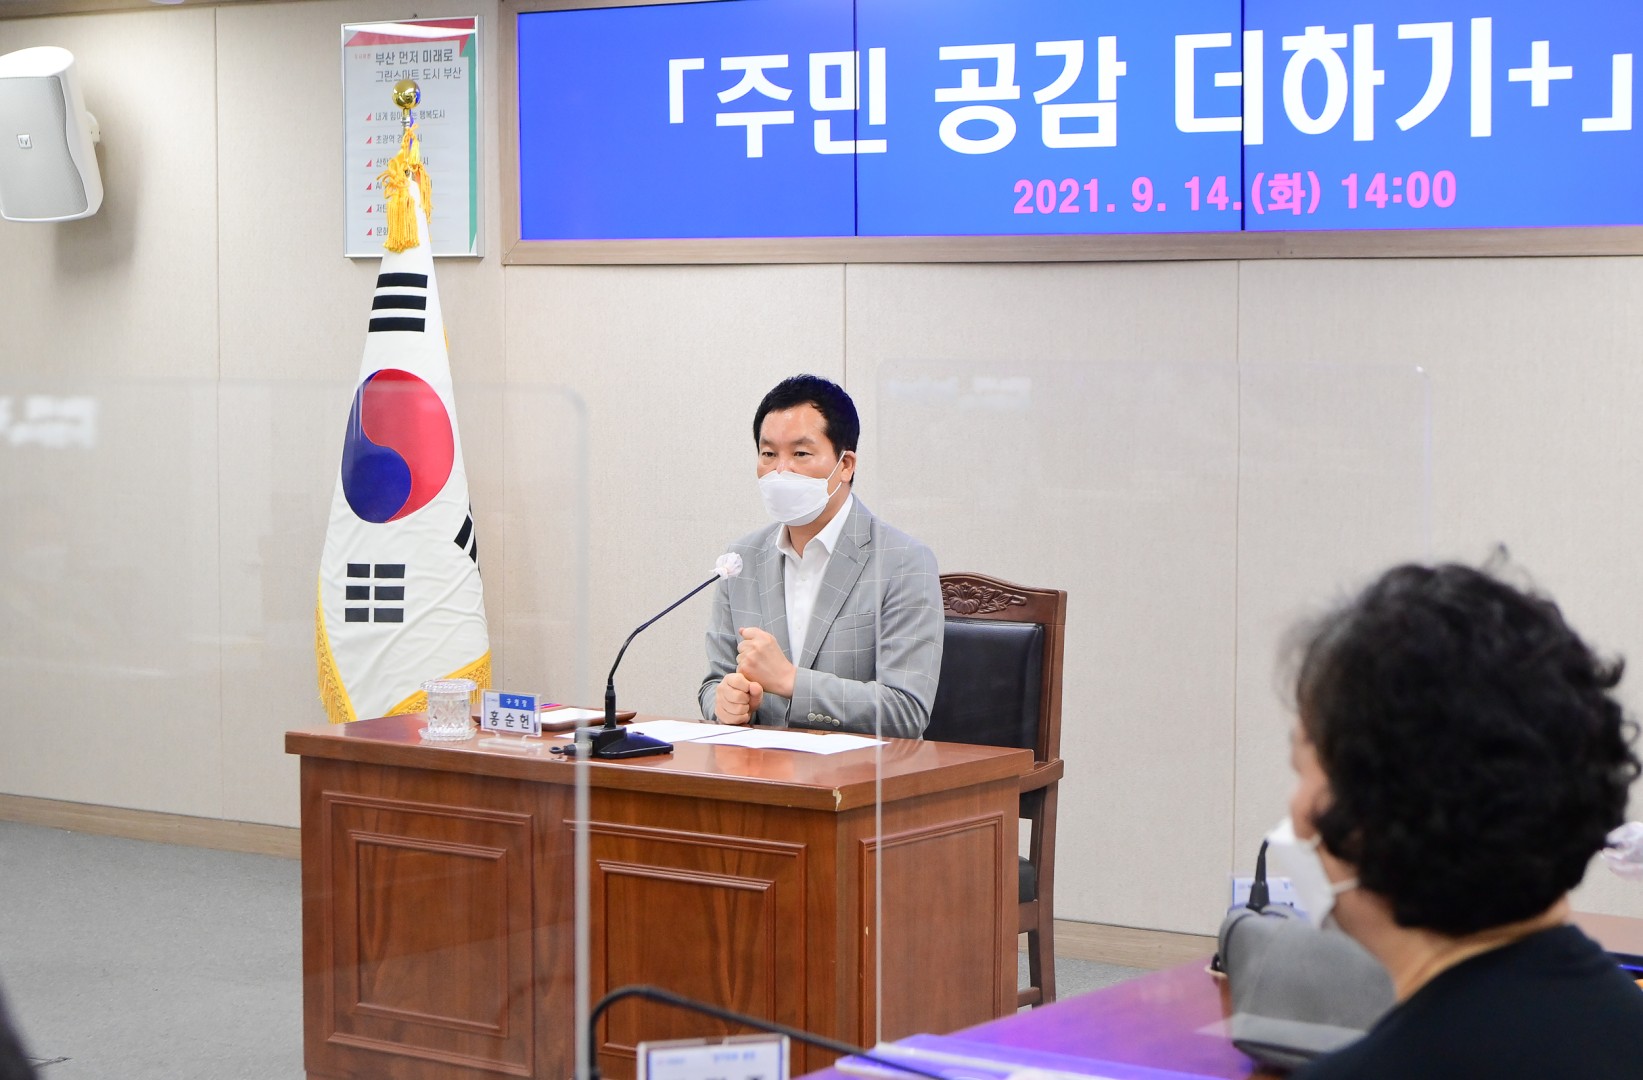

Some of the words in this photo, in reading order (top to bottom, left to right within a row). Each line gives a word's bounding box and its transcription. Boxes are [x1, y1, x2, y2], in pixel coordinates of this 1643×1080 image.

[375, 51, 395, 65] 부산
[399, 50, 419, 64] 먼저
[422, 48, 453, 63] 미래로
[375, 68, 419, 82] 그린스마트
[423, 67, 440, 80] 도시
[443, 66, 462, 79] 부산
[668, 47, 887, 158] 「주민
[934, 35, 1127, 154] 공감
[1013, 177, 1115, 214] 2021.
[1131, 176, 1166, 212] 9.
[1341, 170, 1457, 209] 14:00
